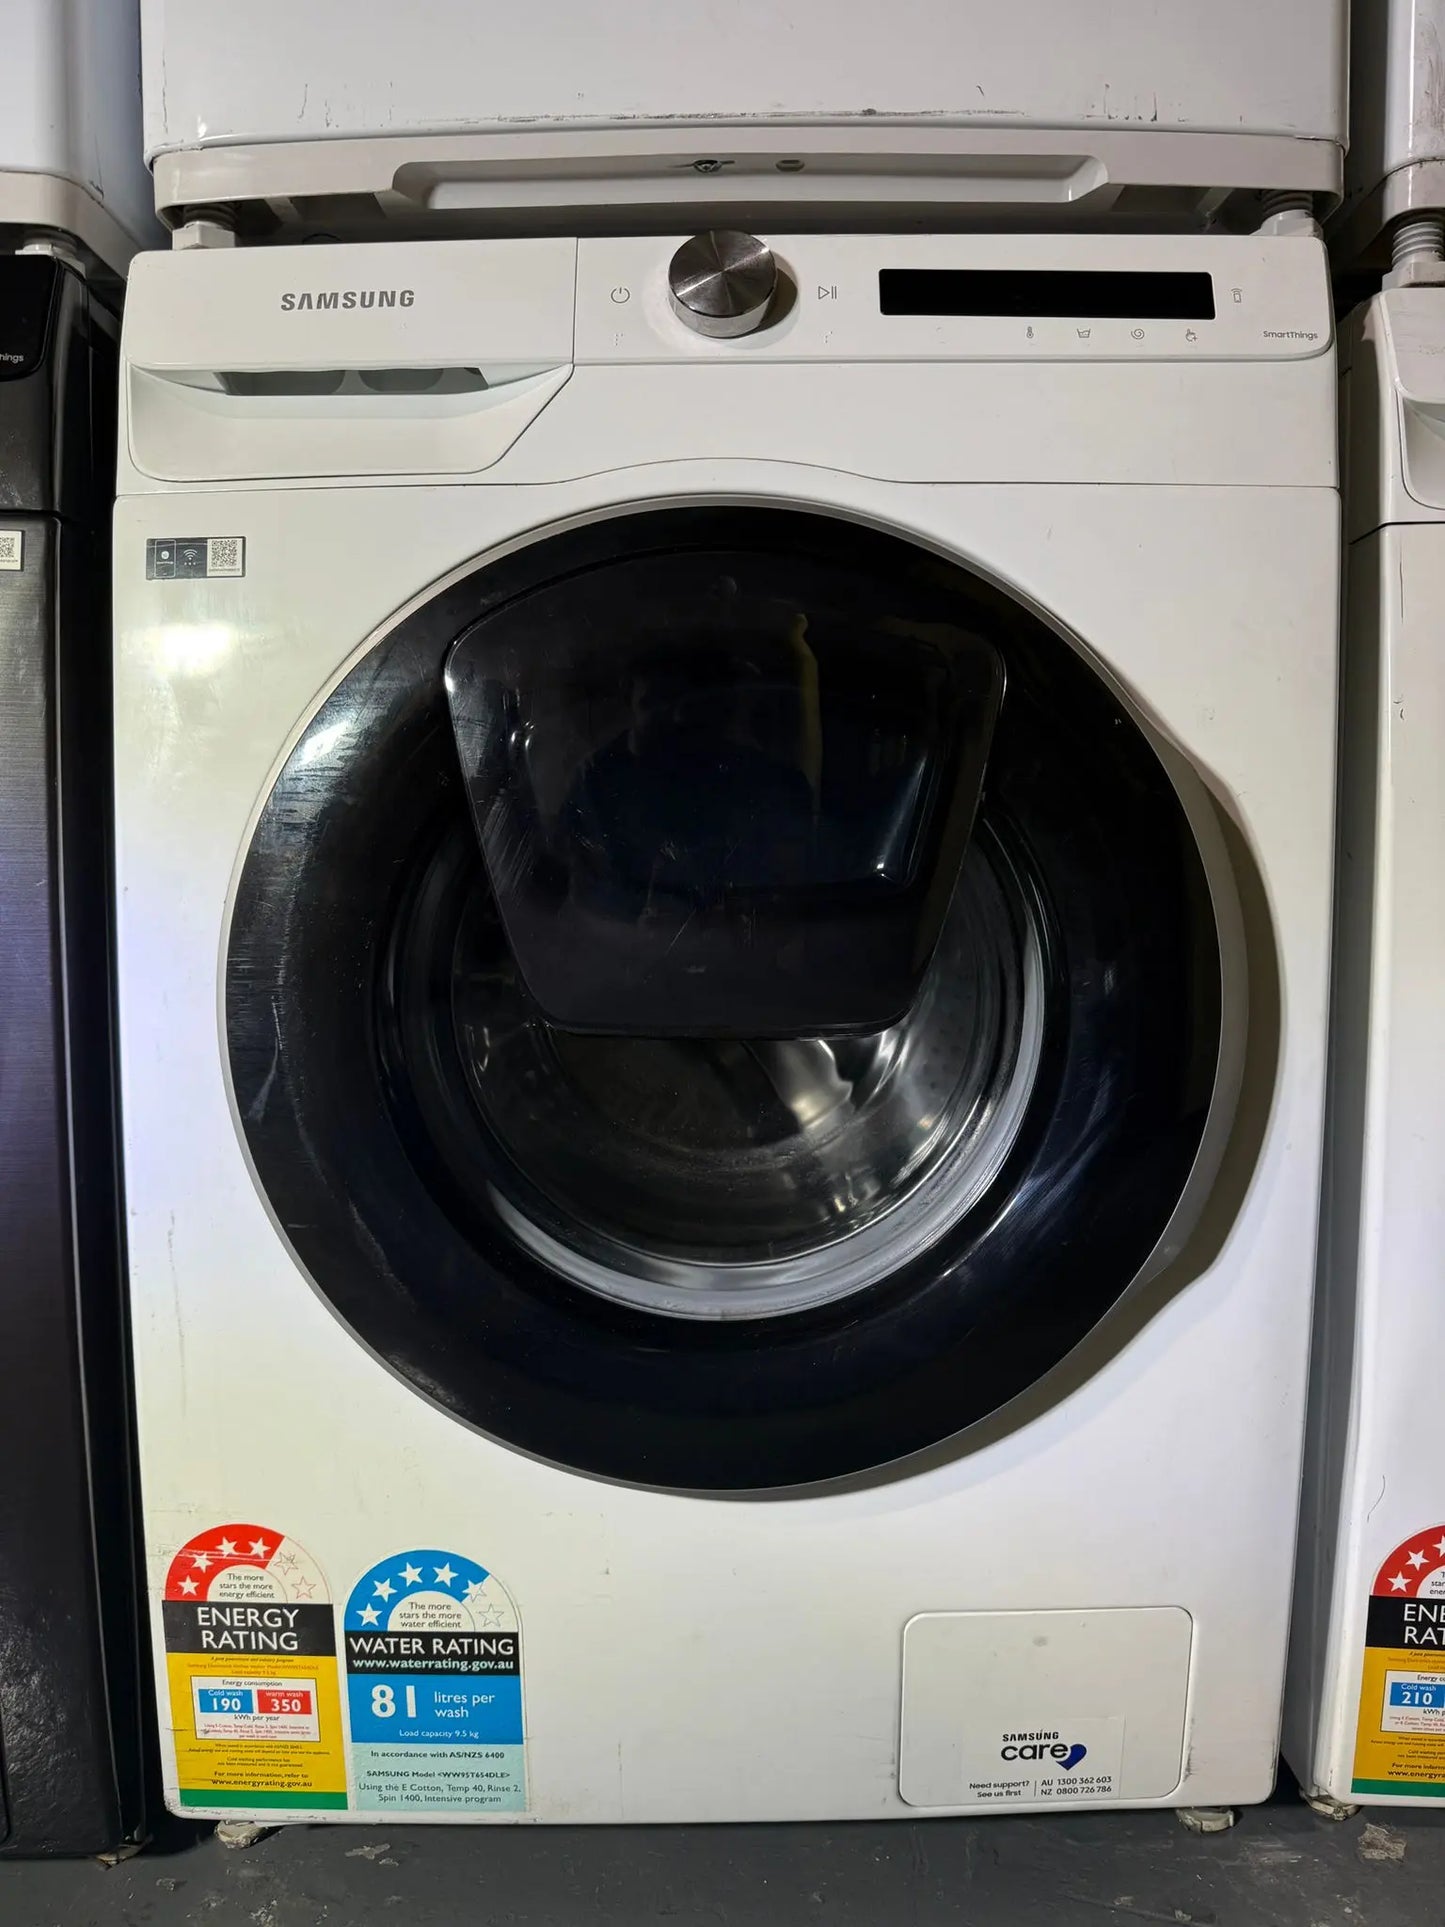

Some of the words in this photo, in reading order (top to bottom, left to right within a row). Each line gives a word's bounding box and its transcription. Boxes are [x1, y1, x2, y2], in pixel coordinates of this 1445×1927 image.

[280, 290, 415, 311] SAMSUNG
[1263, 330, 1318, 341] SmartThings
[227, 1573, 242, 1581] The
[219, 1591, 244, 1600] energy
[245, 1591, 275, 1599] efficient
[409, 1602, 426, 1610] The
[197, 1607, 299, 1628] ENERGY
[400, 1620, 425, 1628] water
[427, 1620, 462, 1628] efficient
[202, 1630, 298, 1651] RATING
[349, 1637, 425, 1654] WATER
[433, 1638, 514, 1655] RATING
[352, 1658, 514, 1672] www.waterrating.gov.au
[222, 1679, 242, 1687] Energy
[1417, 1674, 1438, 1682] Energy
[434, 1691, 467, 1704] litres
[472, 1694, 495, 1707] per
[1402, 1691, 1433, 1705] 210
[212, 1698, 242, 1711] 190
[271, 1699, 302, 1712] 350
[434, 1707, 469, 1718] wash
[399, 1729, 419, 1737] Load
[421, 1730, 452, 1738] capacity
[469, 1730, 479, 1739] kg
[1002, 1731, 1059, 1742] SAMSUNG
[381, 1750, 427, 1758] accordance
[449, 1751, 483, 1759] AS/NZS
[1001, 1743, 1068, 1761] care
[366, 1770, 409, 1778] SAMSUNG
[211, 1779, 313, 1788] www.energyrating.gov.au
[969, 1781, 992, 1789] Need
[993, 1780, 1030, 1789] support?
[1078, 1777, 1095, 1785] 362
[1096, 1776, 1112, 1784] 603
[358, 1783, 382, 1792] Using
[409, 1784, 444, 1793] Cotton,
[447, 1784, 469, 1793] Temp
[1056, 1787, 1078, 1795] 0800
[1080, 1786, 1095, 1794] 726
[1096, 1785, 1112, 1793] 786
[378, 1794, 396, 1803] Spin
[464, 1796, 502, 1804] program
